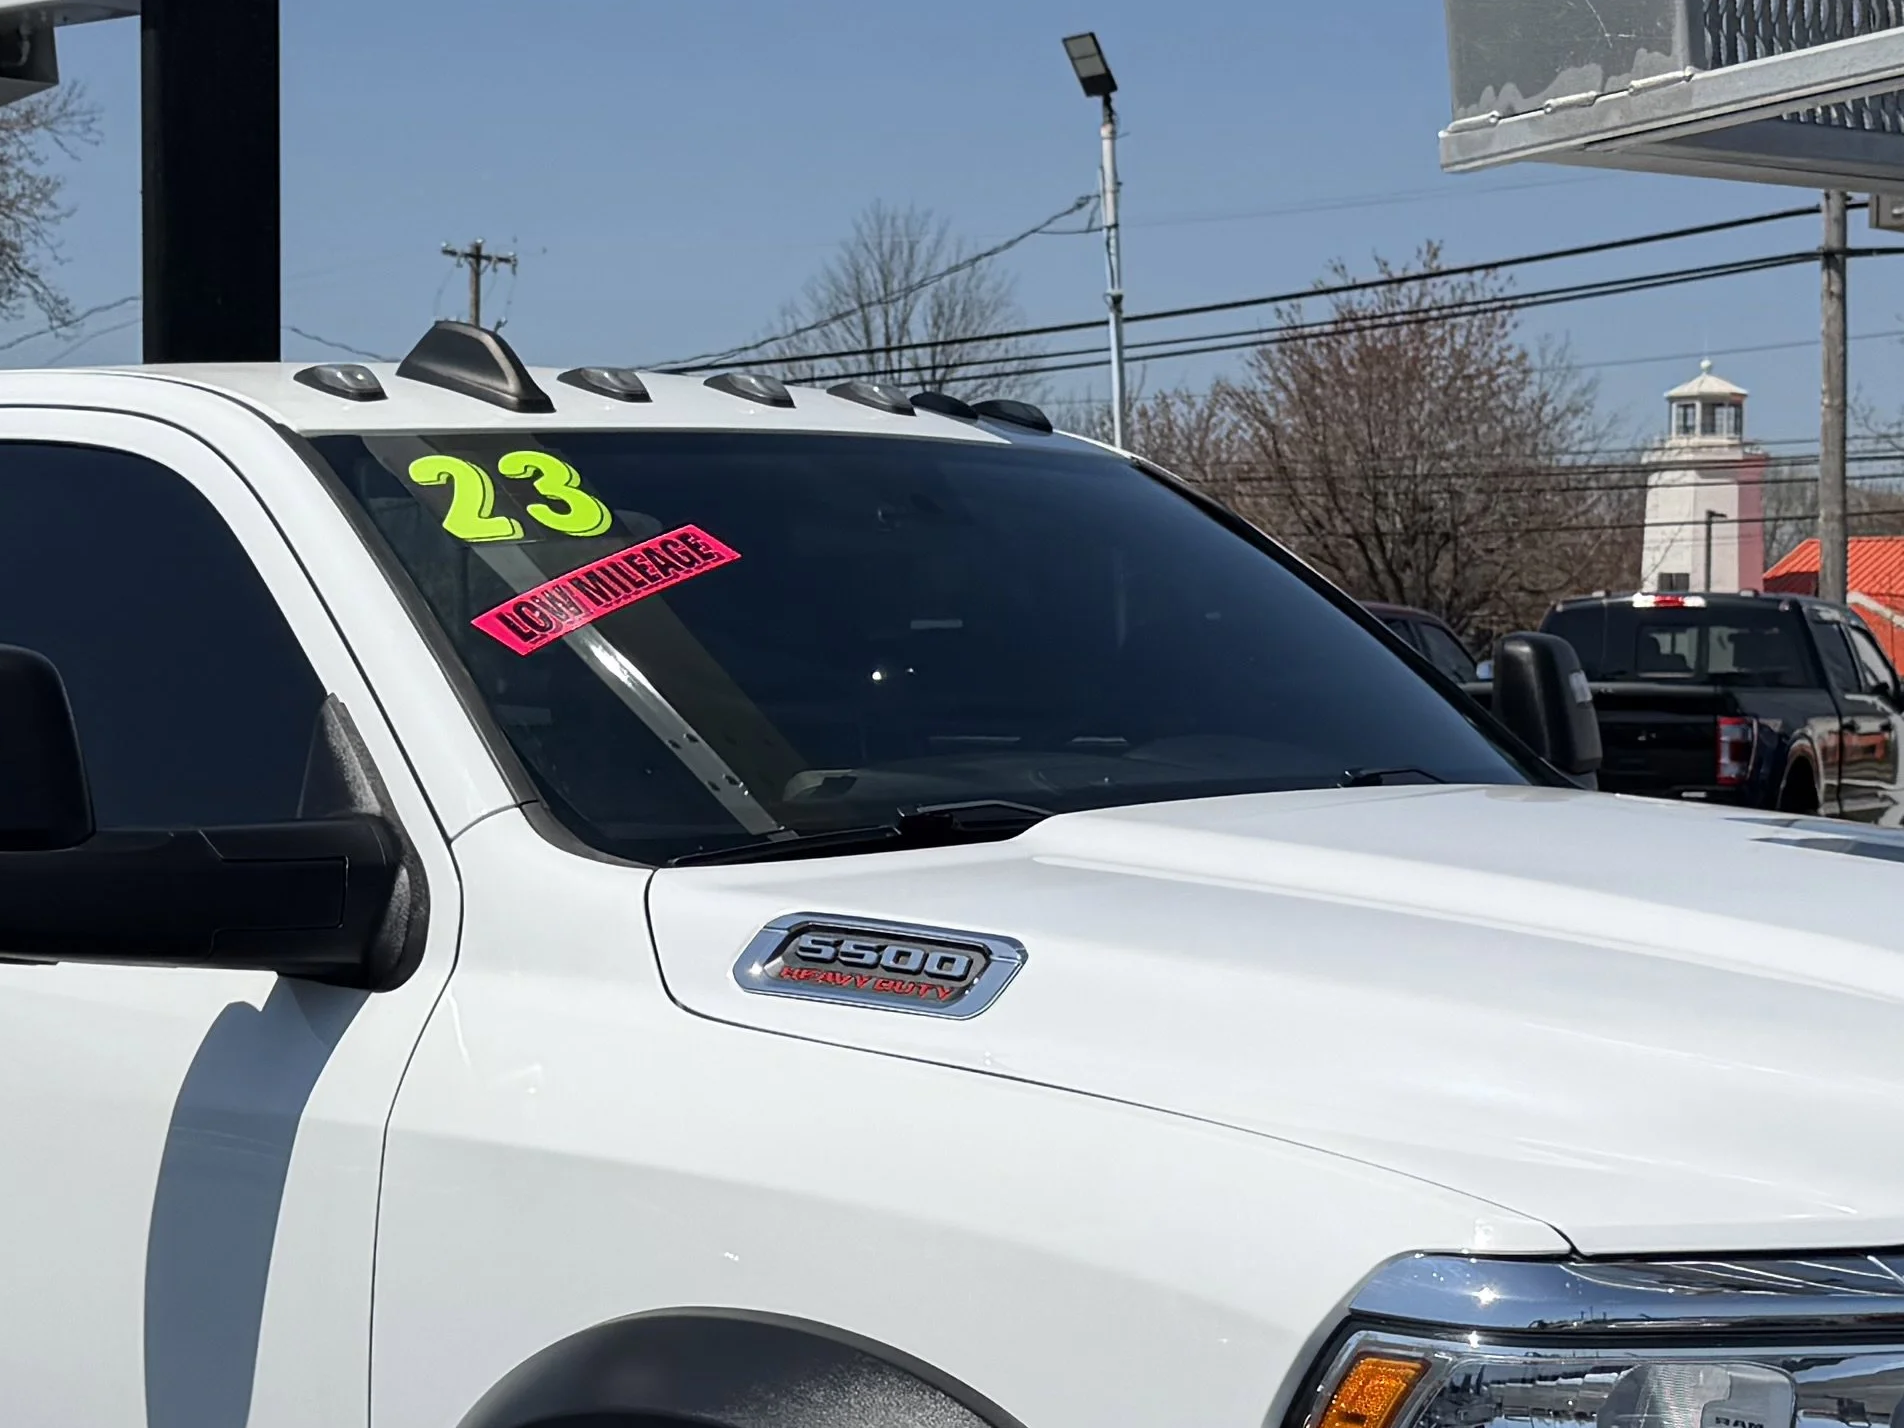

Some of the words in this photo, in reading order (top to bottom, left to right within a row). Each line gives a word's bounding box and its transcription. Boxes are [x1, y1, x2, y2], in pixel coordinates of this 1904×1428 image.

[409, 451, 612, 540] 23
[497, 584, 587, 643] LOW
[568, 532, 718, 607] MILEAGE
[779, 966, 872, 990] HEAVY
[872, 978, 957, 1002] DUTY
[796, 933, 973, 982] 5500
